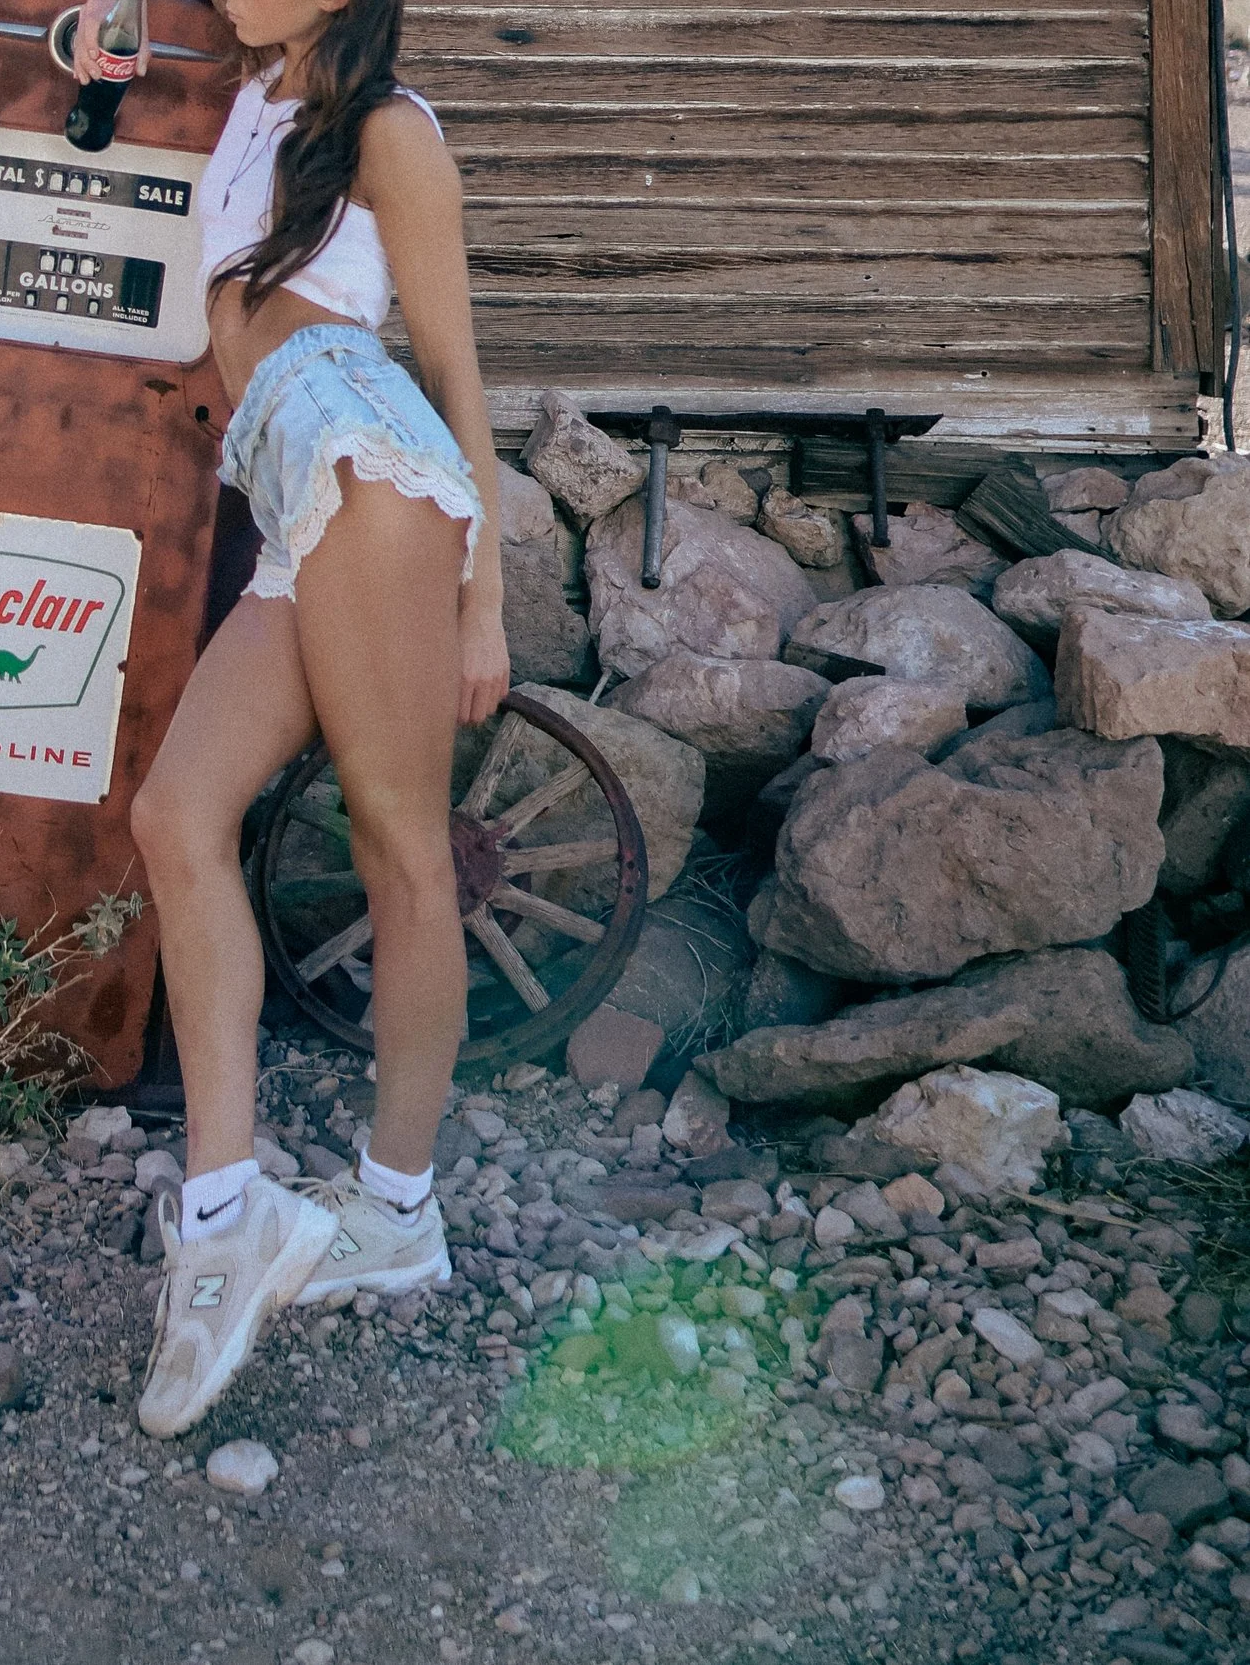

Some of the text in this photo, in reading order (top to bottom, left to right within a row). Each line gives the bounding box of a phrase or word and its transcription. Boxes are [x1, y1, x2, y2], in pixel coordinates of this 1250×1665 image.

[34, 168, 45, 188] $
[138, 185, 184, 206] SALE
[19, 271, 114, 299] GALLONS
[6, 290, 21, 298] PER
[112, 305, 150, 317] ALL TAXES
[112, 312, 148, 324] INCLUDED
